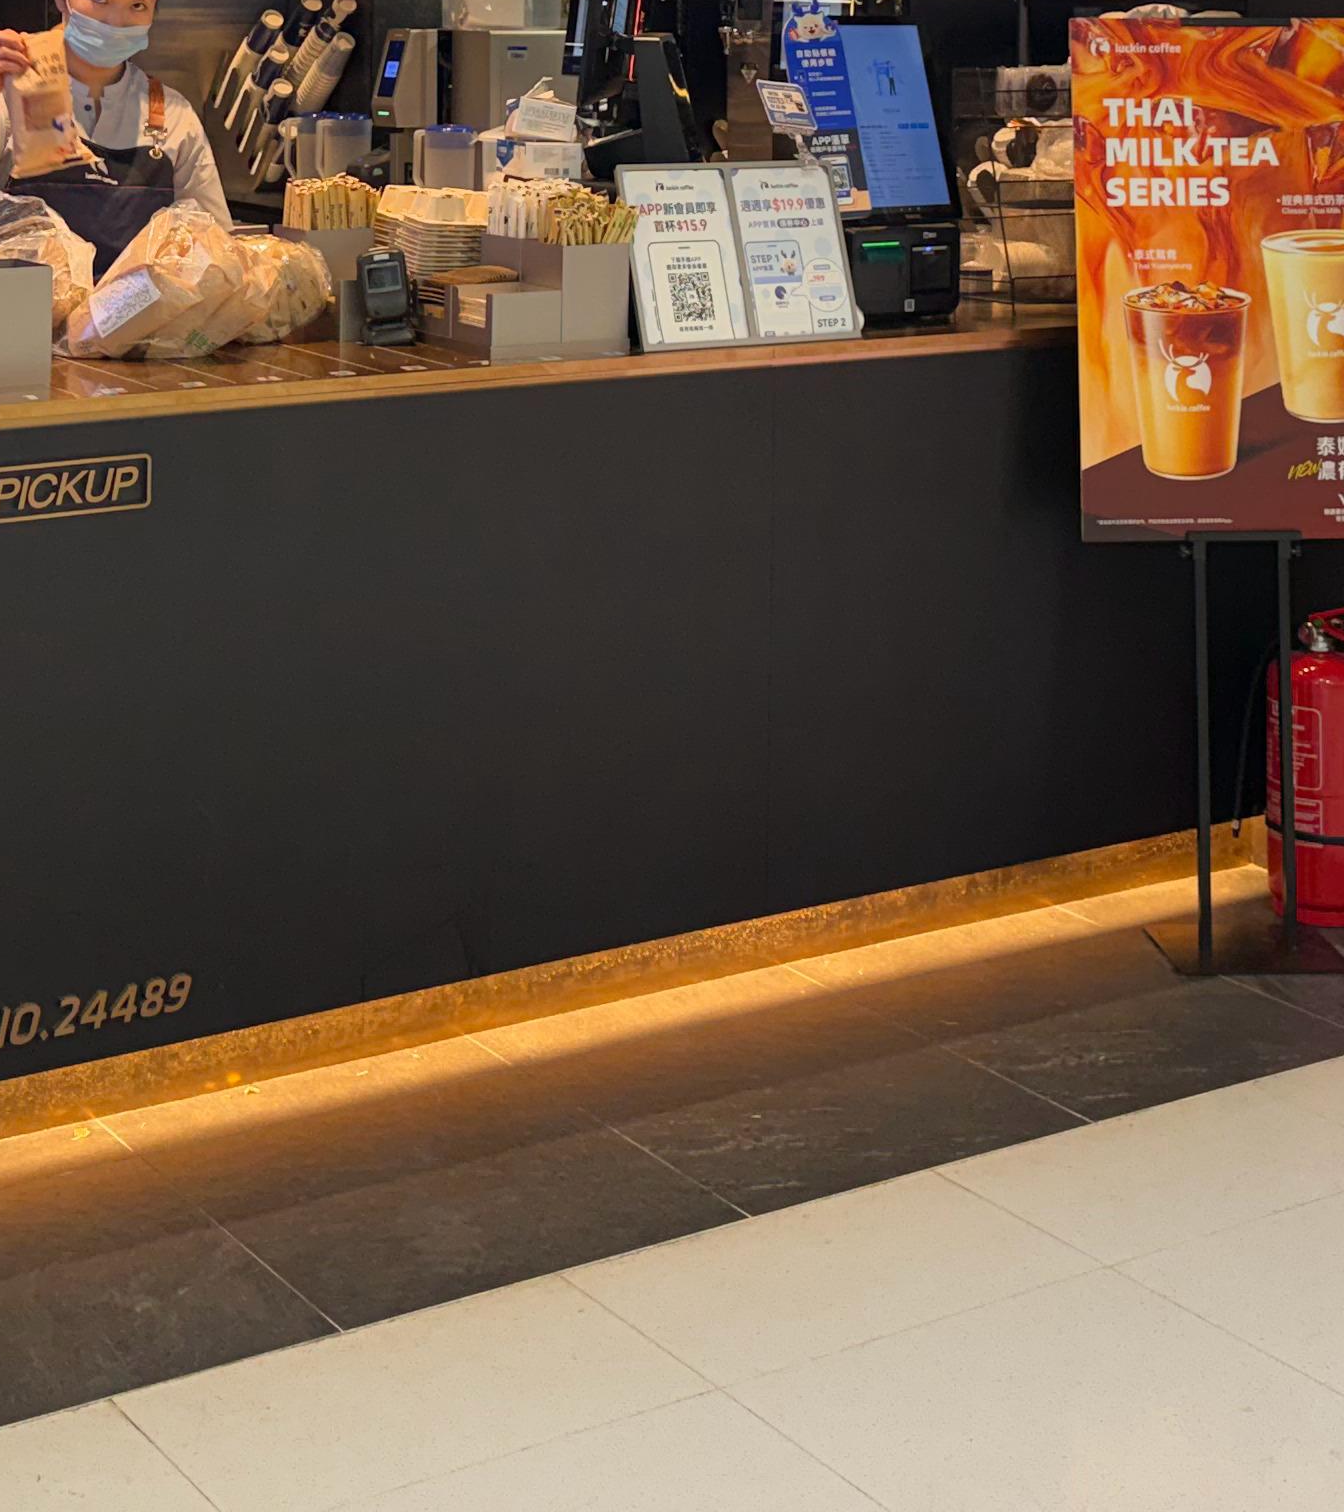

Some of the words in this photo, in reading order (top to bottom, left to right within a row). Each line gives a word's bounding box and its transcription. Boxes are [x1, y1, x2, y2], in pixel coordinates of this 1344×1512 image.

[1115, 42, 1146, 53] luckin
[1148, 42, 1181, 53] coffee
[1103, 97, 1193, 127] THAI
[1106, 137, 1200, 166] MILK
[1207, 137, 1280, 166] TEA
[1106, 177, 1230, 207] SERIES
[750, 255, 773, 264] STEP
[817, 318, 839, 327] STEP
